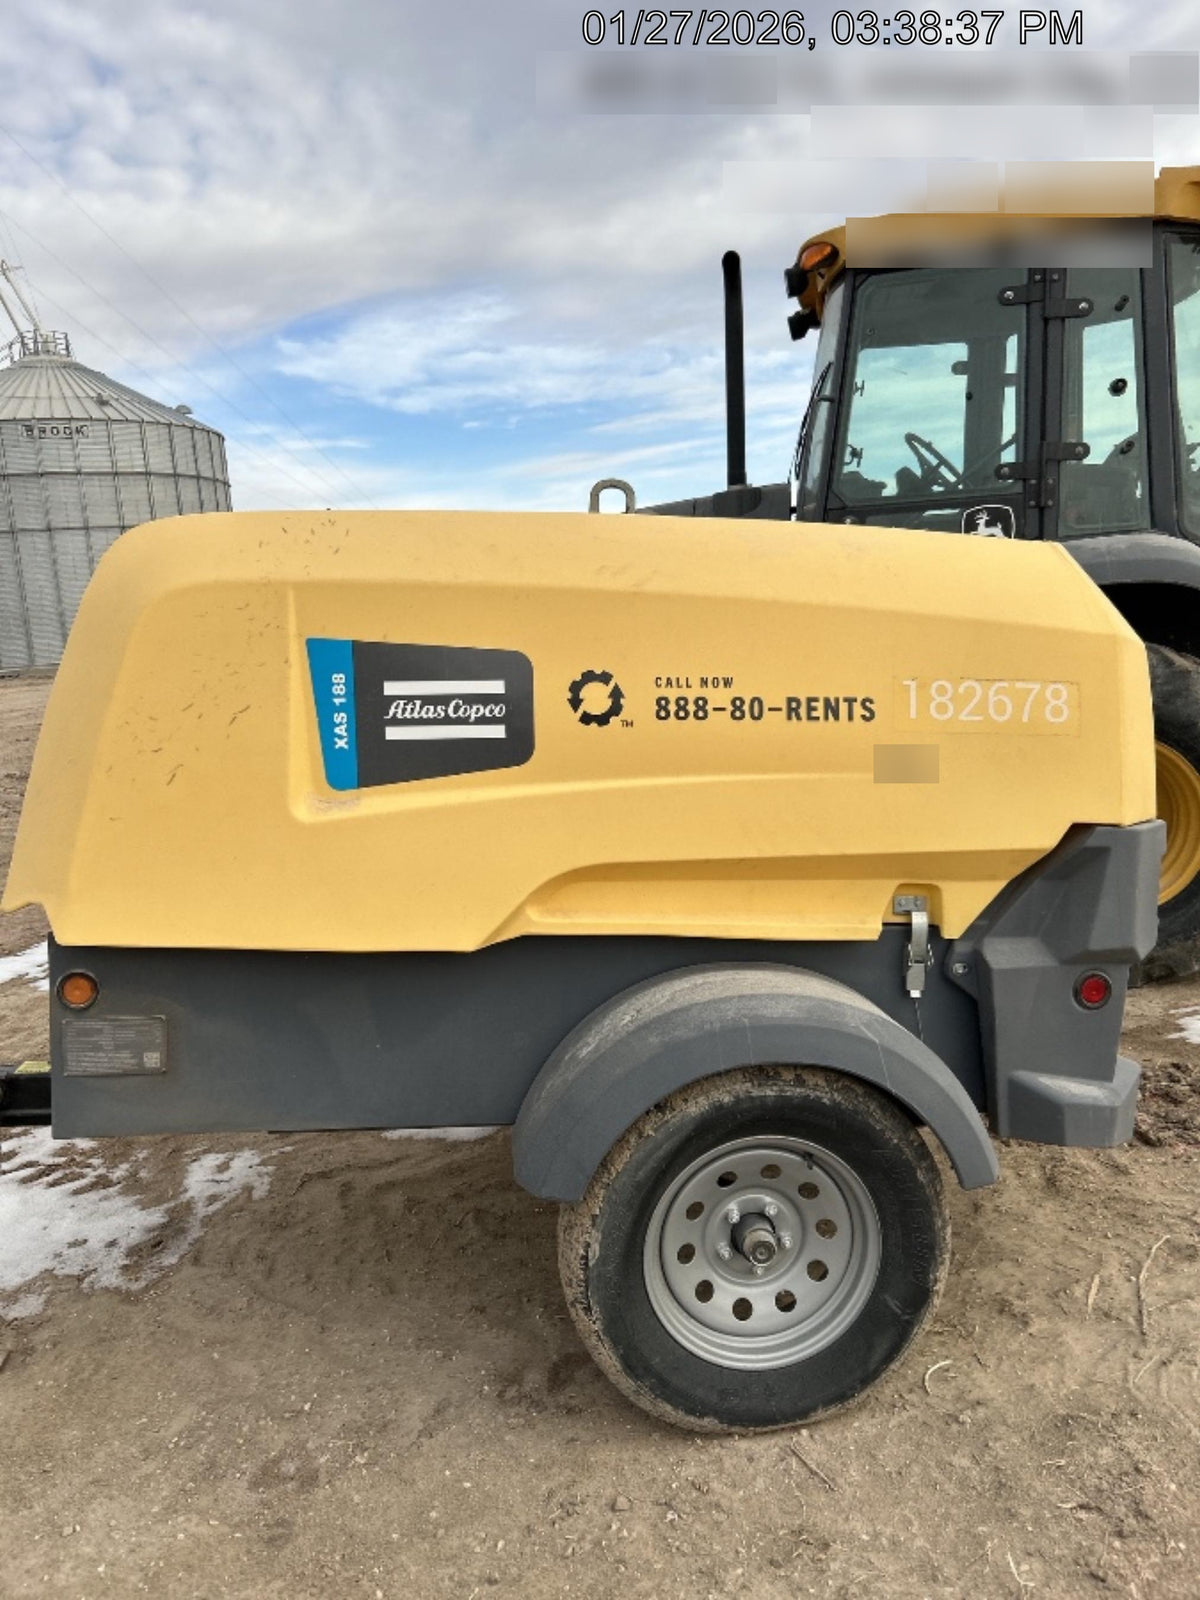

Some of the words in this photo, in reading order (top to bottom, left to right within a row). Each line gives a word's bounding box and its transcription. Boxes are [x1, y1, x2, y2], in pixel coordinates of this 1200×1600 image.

[332, 673, 346, 706] 188
[655, 677, 692, 688] CALL
[700, 677, 733, 688] NOW
[655, 696, 876, 722] 888-80-RENTS
[902, 679, 1070, 723] 182678
[333, 712, 349, 749] XAS
